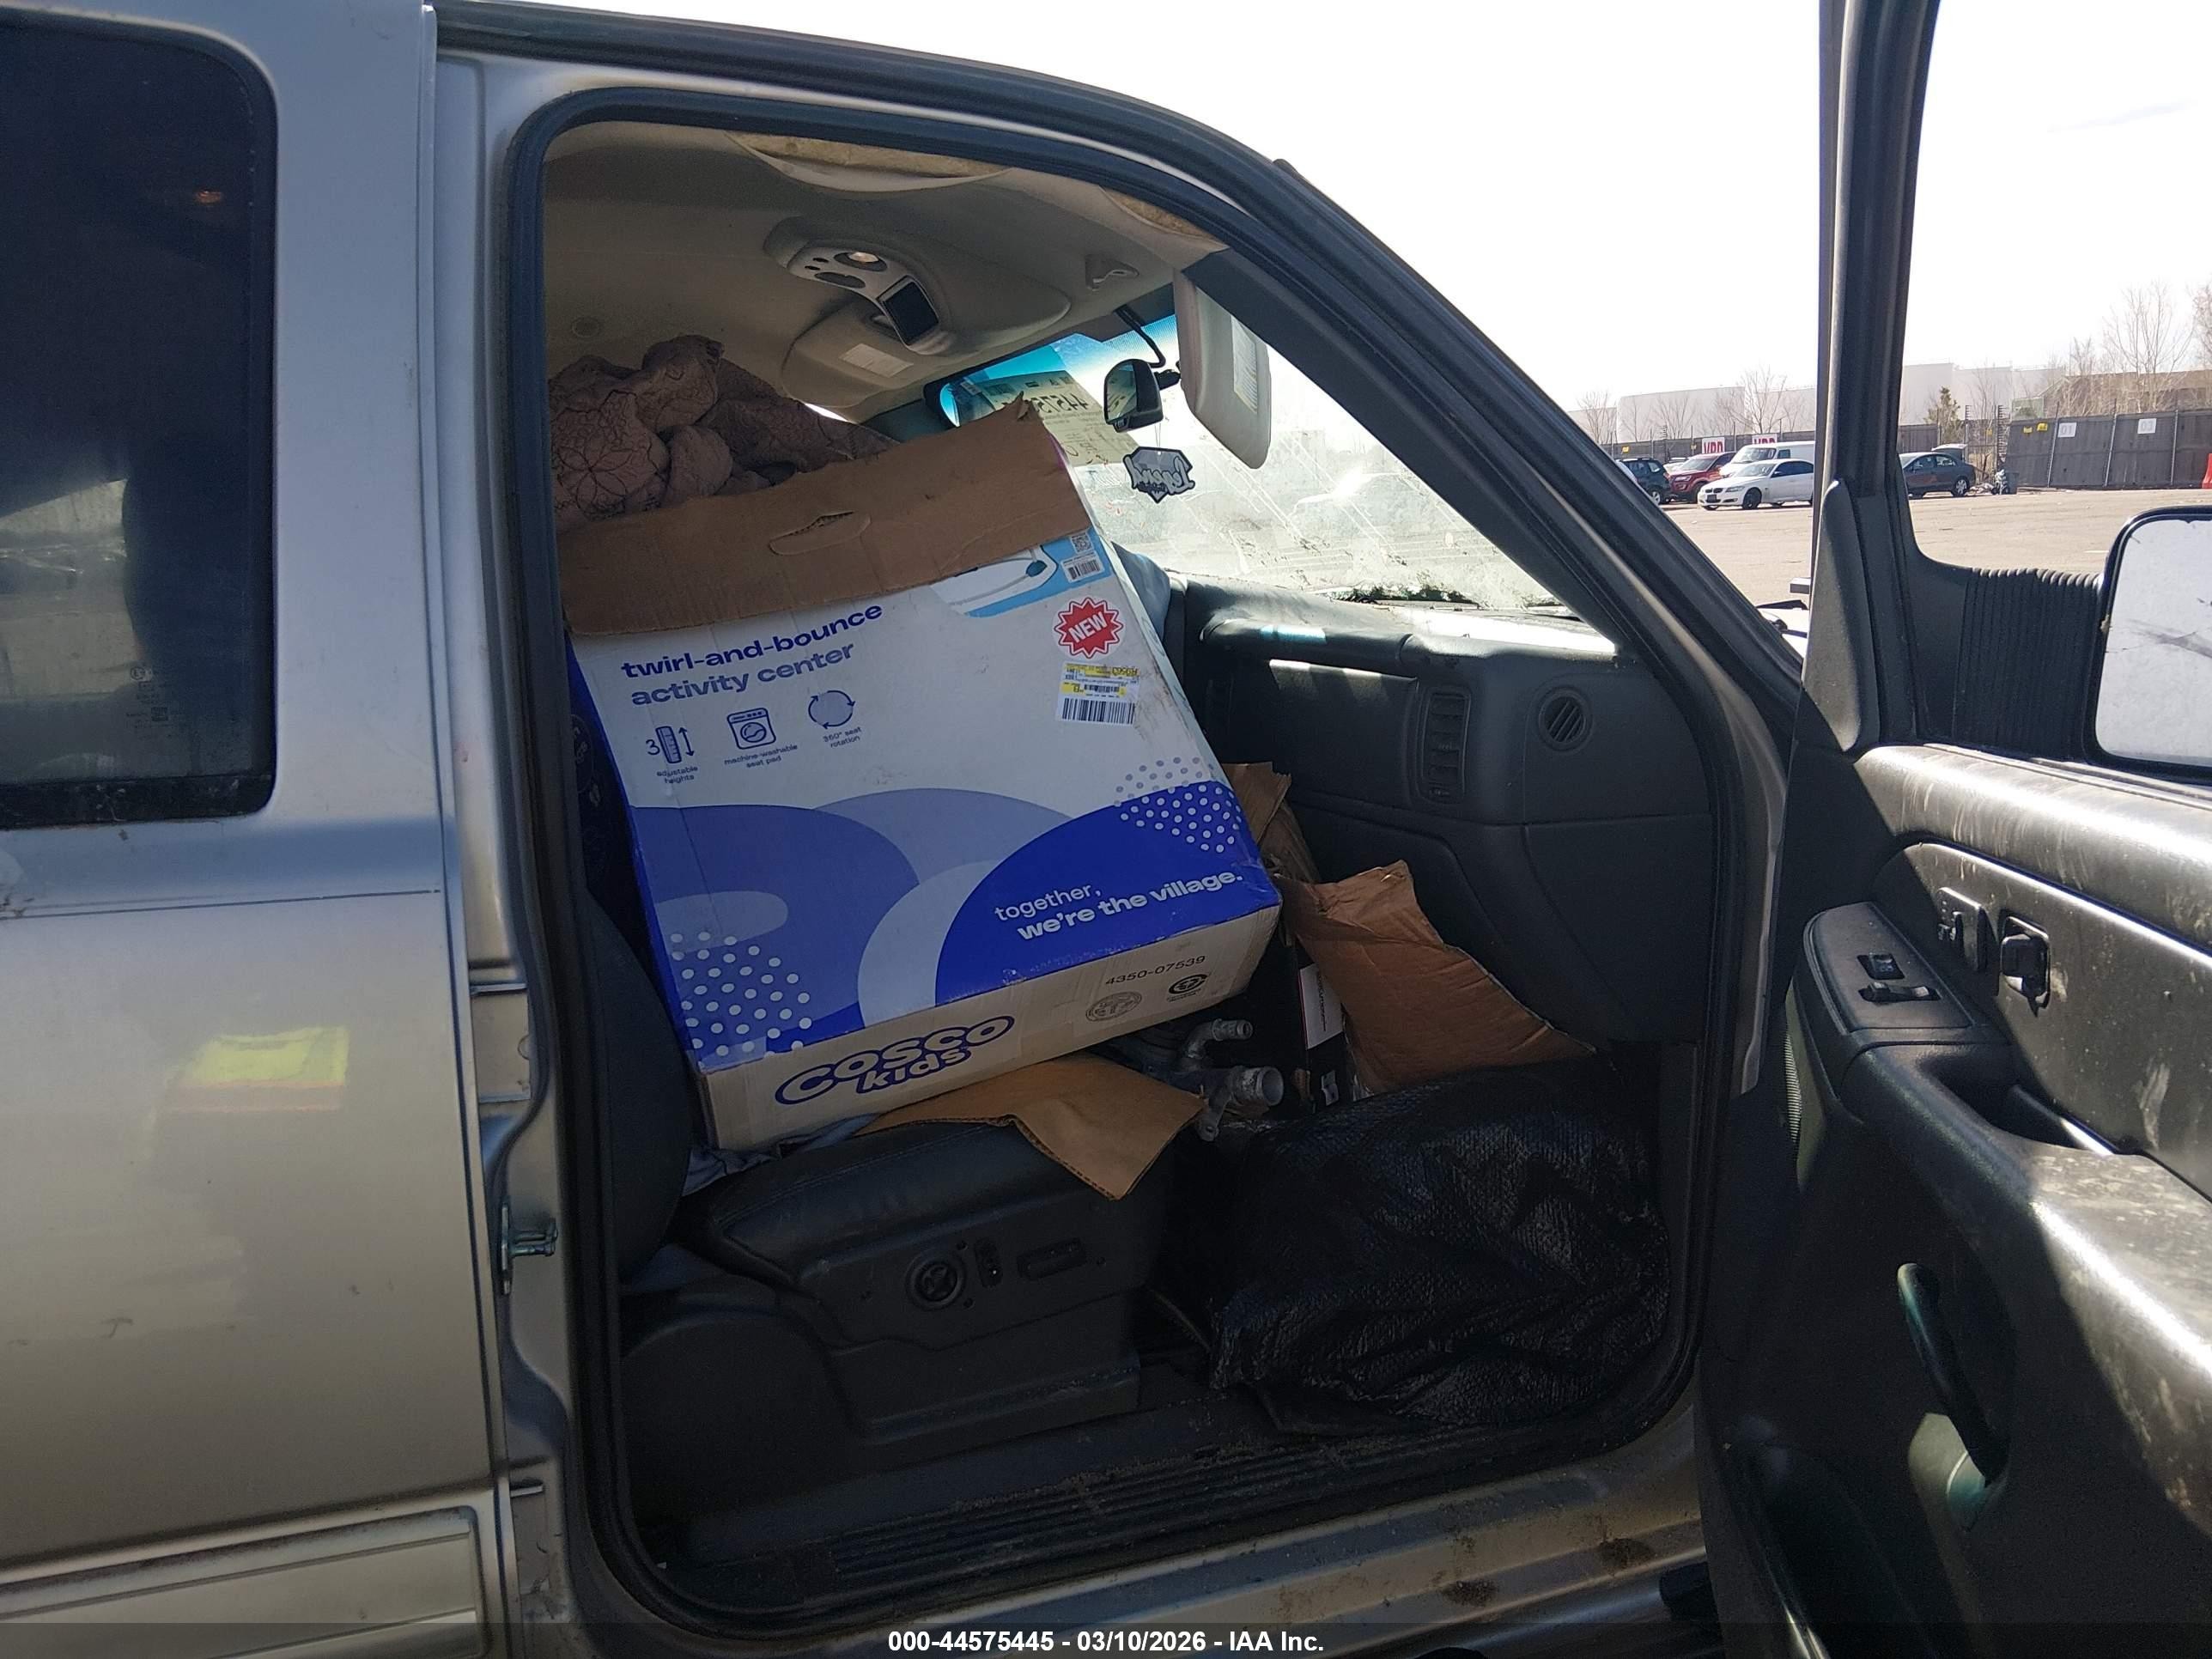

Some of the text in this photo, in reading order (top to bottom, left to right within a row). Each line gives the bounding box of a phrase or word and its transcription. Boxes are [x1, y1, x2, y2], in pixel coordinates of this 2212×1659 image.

[1068, 611, 1108, 643] NEW
[621, 605, 883, 678] twirl-and-bounce
[631, 643, 854, 706] activity center
[646, 738, 660, 756] 3
[724, 743, 798, 766] machine-washable
[830, 735, 860, 749] rotation
[656, 765, 699, 778] adjustable
[745, 755, 782, 769] seat pad
[664, 774, 695, 785] heights
[994, 884, 1101, 921] together,
[1097, 892, 1148, 917] the
[1149, 871, 1243, 902] village.
[1105, 955, 1206, 987] 4350-07539
